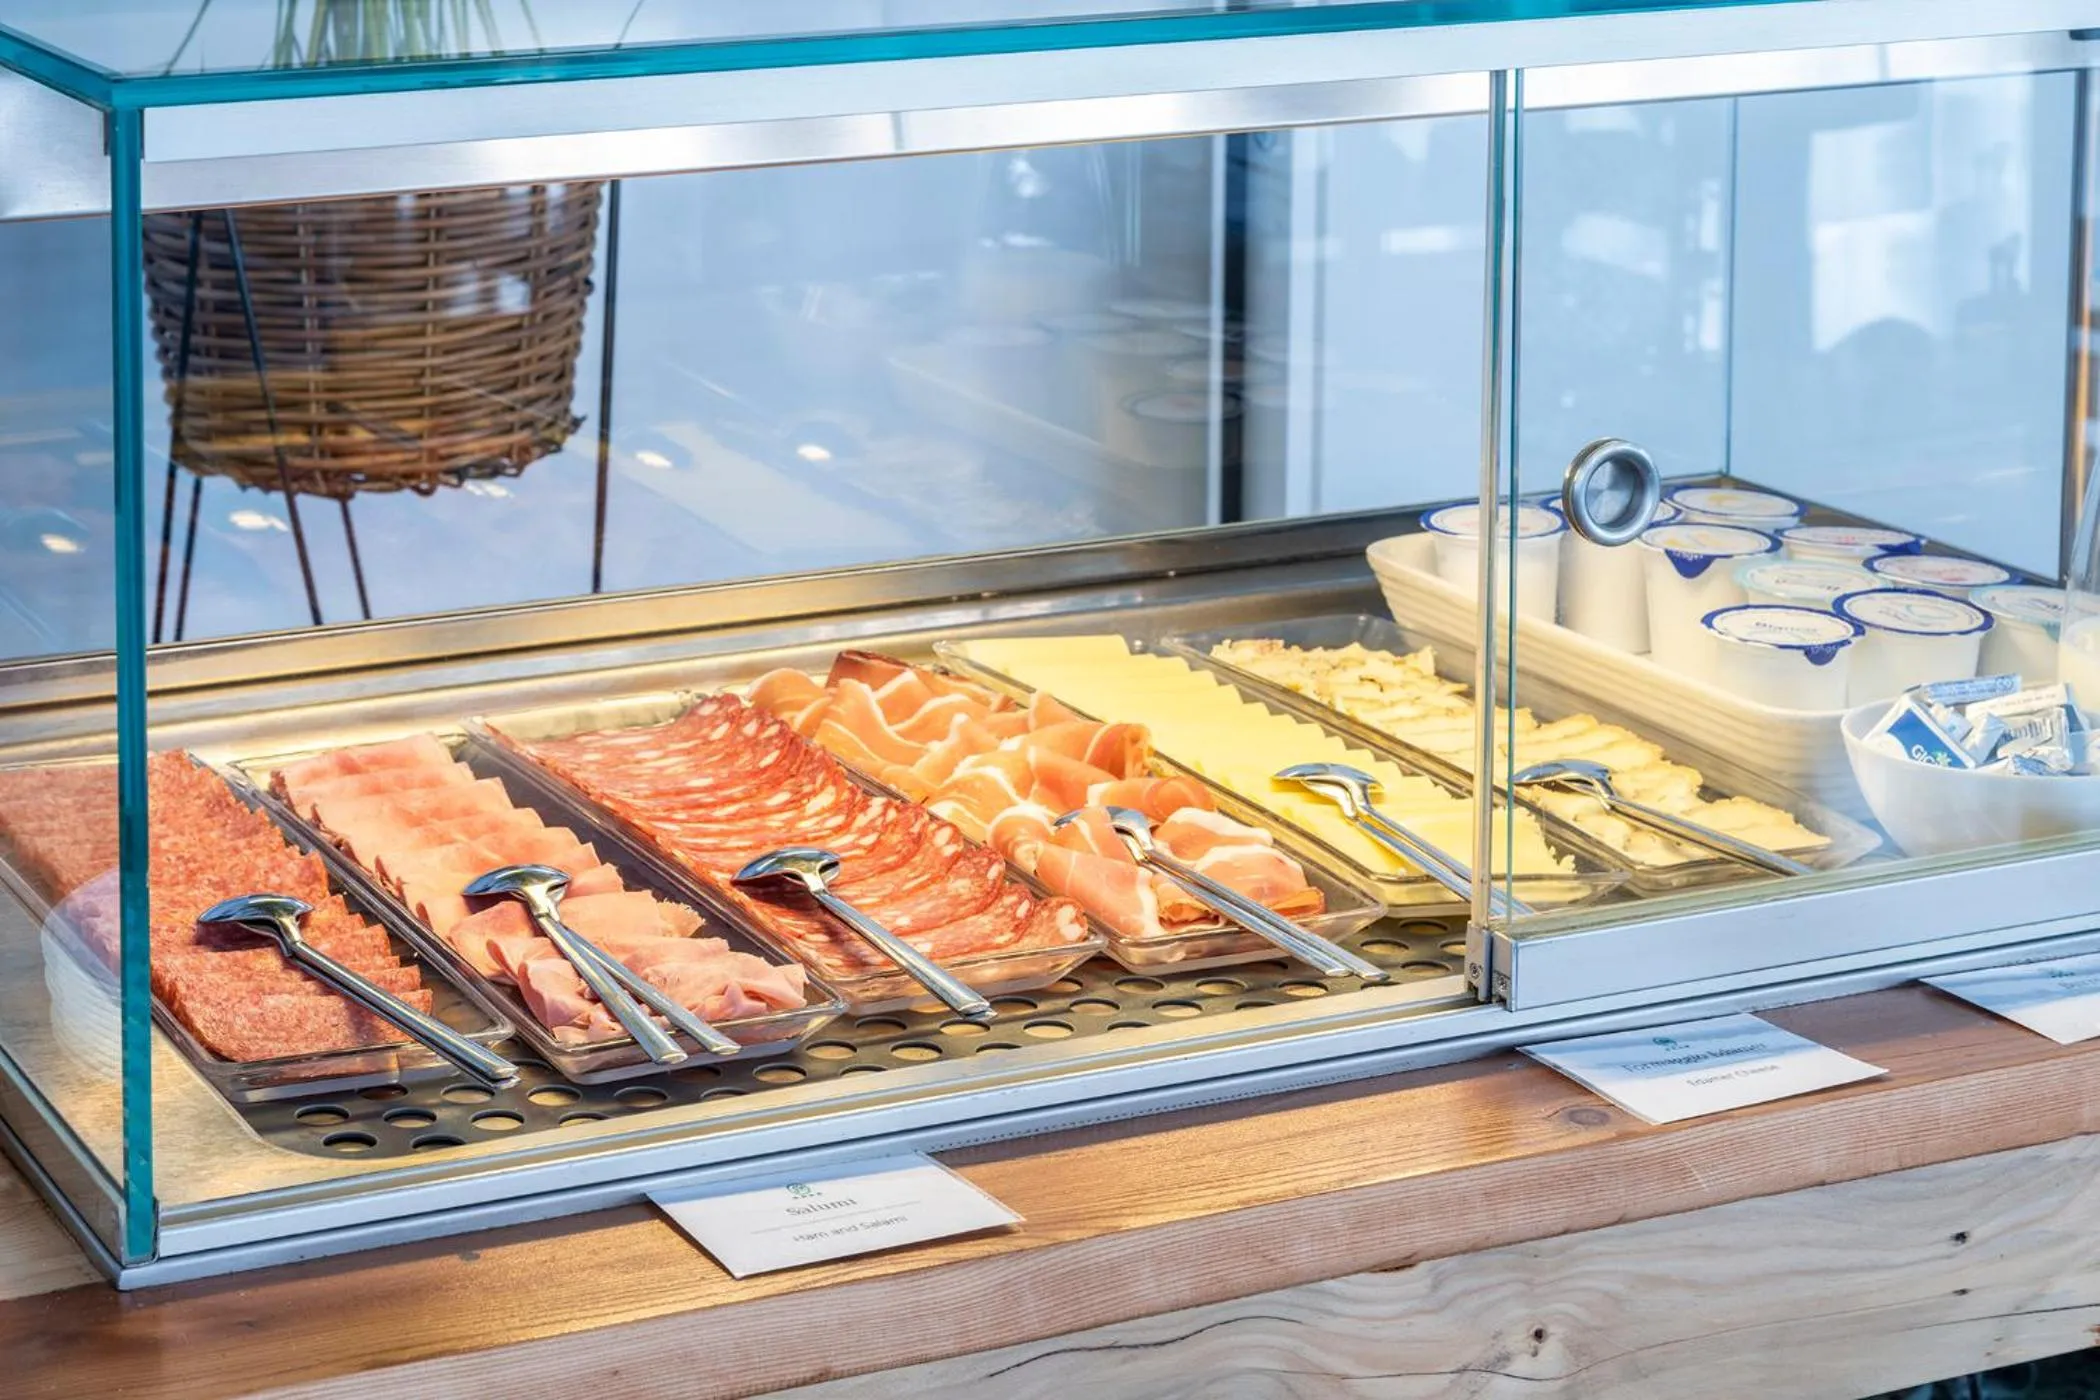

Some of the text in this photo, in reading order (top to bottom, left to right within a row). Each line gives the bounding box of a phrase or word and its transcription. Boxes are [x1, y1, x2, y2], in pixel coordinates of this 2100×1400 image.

[785, 1198, 858, 1216] Salumi
[793, 1215, 909, 1242] Ham and Salami
